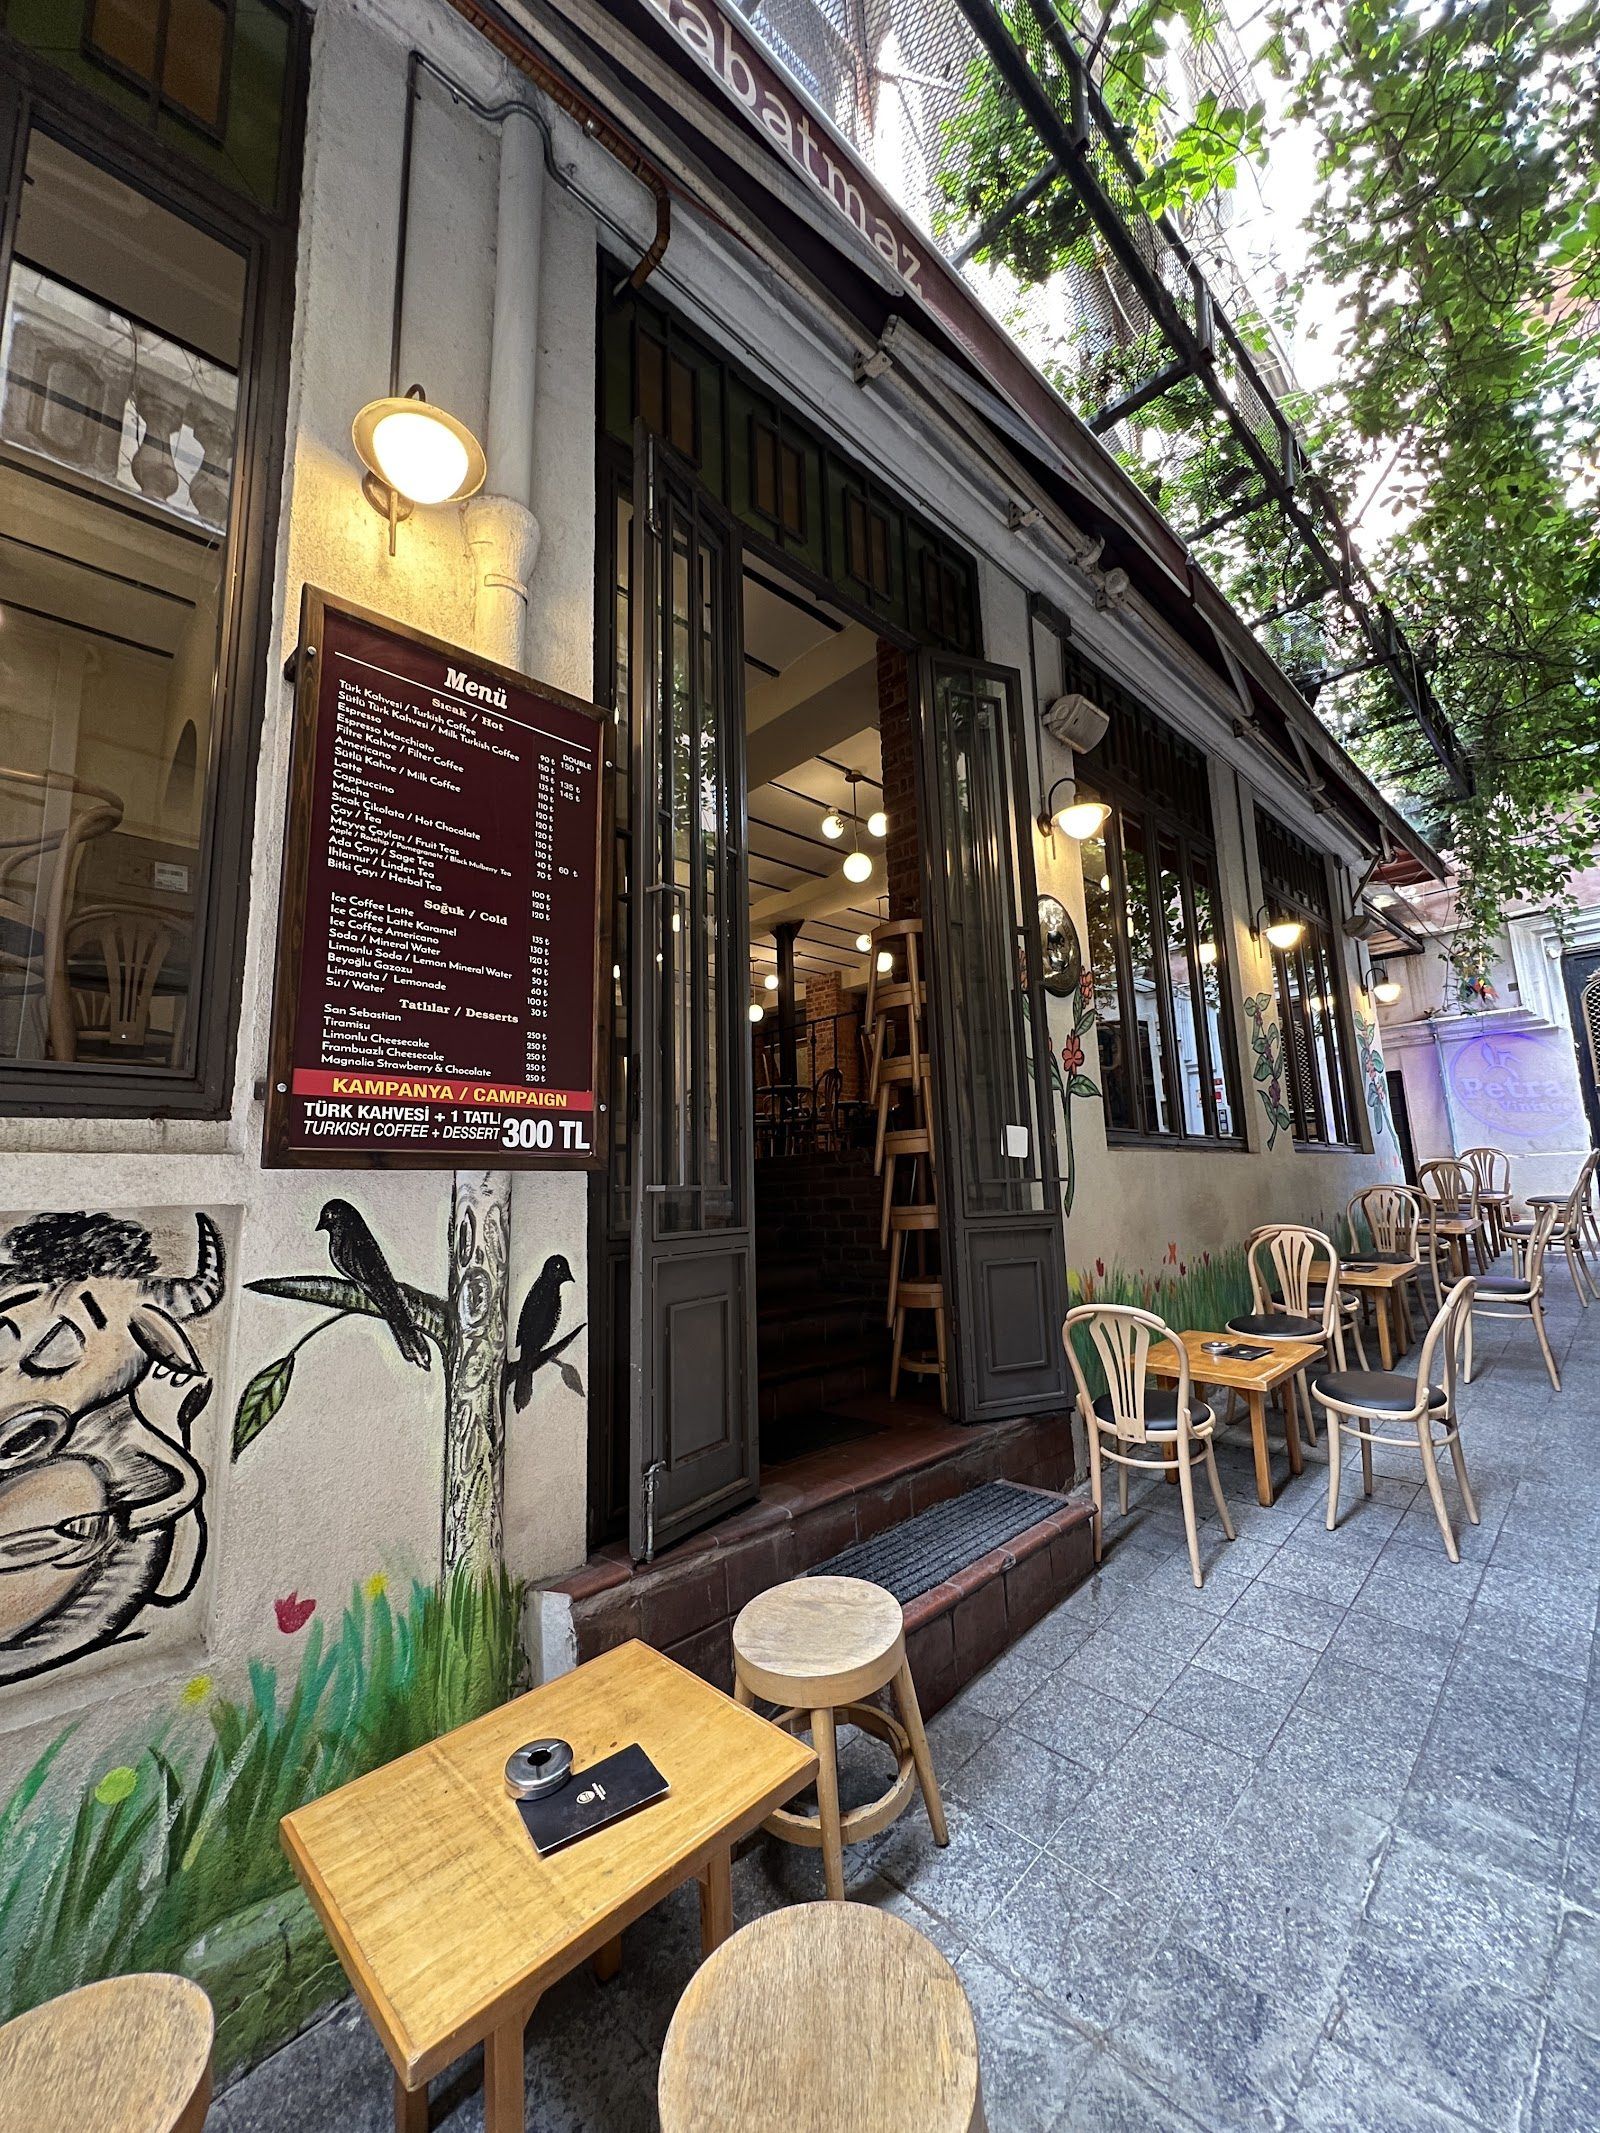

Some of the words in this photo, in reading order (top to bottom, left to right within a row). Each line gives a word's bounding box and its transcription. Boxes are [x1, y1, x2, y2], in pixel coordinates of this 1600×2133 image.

[648, 0, 923, 299] abatmaz
[444, 667, 508, 710] Menü
[338, 702, 382, 724] Espresso
[339, 679, 362, 695] Türk
[364, 688, 402, 709] Kahvesi
[412, 706, 444, 724] Turkish
[446, 719, 476, 736] Coffee
[432, 698, 467, 718] Sıcak
[471, 713, 478, 722] /
[482, 716, 504, 732] Hot
[337, 713, 381, 734] Espresso
[384, 728, 435, 752] Macchiato
[368, 700, 389, 716] Türk
[392, 709, 428, 729] Kahvesi
[438, 726, 458, 740] Milk
[460, 733, 490, 751] Turkish
[492, 746, 520, 762] Coffee
[335, 736, 391, 760] Americano
[336, 724, 363, 740] Filtre
[365, 733, 397, 751] Kahve
[408, 747, 432, 762] Filter
[433, 756, 464, 773] Coffee
[334, 757, 363, 773] Latte
[538, 763, 550, 773] 150
[540, 755, 550, 764] 90
[561, 762, 574, 772] 150
[563, 754, 592, 770] DOUBLE
[333, 769, 394, 794] Cappuccino
[365, 756, 397, 773] Kahve
[407, 769, 428, 783] Milk
[430, 777, 461, 793] Coffee
[540, 774, 549, 782] 115
[333, 780, 370, 798] Mocha
[539, 783, 549, 792] 135
[560, 781, 574, 791] 135
[538, 792, 548, 802] 110
[560, 790, 574, 800] 145
[331, 804, 353, 818] Çay
[364, 812, 382, 824] Tea
[538, 802, 548, 811] 110
[332, 792, 360, 807] Sıcak
[363, 801, 405, 819] Çikolata
[415, 815, 433, 827] Hot
[435, 821, 481, 840] Chocolate
[536, 811, 548, 821] 120
[536, 821, 548, 830] 120
[330, 815, 366, 832] Meyve
[415, 837, 437, 850] Fruit
[439, 843, 459, 856] Teas
[535, 831, 547, 840] 120
[329, 825, 352, 836] Apple
[360, 832, 390, 846] Rosehip
[450, 856, 468, 866] Black
[469, 861, 498, 874] Mulberry
[500, 868, 512, 877] Tea
[329, 835, 352, 848] Ada
[354, 841, 378, 855] Çayı
[389, 850, 415, 864] Sage
[417, 856, 434, 868] Tea
[536, 840, 547, 850] 130
[535, 850, 547, 860] 130
[328, 858, 351, 871] Bitki
[354, 865, 378, 878] Çayı
[389, 872, 423, 888] Herbal
[425, 880, 442, 892] Tea
[381, 859, 416, 875] Linden
[418, 867, 435, 879] Tea
[537, 871, 546, 879] 70
[559, 867, 569, 875] 60
[532, 890, 545, 900] 100
[332, 892, 347, 903] Ice
[349, 896, 385, 911] Coffee
[387, 904, 414, 917] Latte
[424, 900, 465, 916] Soğuk
[469, 910, 476, 919] /
[480, 912, 508, 926] Cold
[532, 901, 545, 910] 120
[331, 904, 346, 915] Ice
[349, 908, 384, 923] Coffee
[387, 915, 414, 928] Latte
[416, 921, 457, 936] Karamel
[532, 911, 544, 920] 120
[330, 916, 346, 927] Ice
[348, 920, 384, 934] Coffee
[385, 927, 439, 944] Americano
[329, 928, 358, 941] Soda
[369, 935, 409, 950] Mineral
[411, 942, 441, 956] Water
[532, 936, 543, 945] 135
[530, 946, 543, 955] 130
[328, 952, 371, 968] Beyoğlu
[374, 960, 413, 974] Gazozu
[329, 940, 373, 956] Limonlu
[375, 948, 402, 961] Soda
[413, 954, 447, 968] Lemon
[449, 961, 484, 975] Mineral
[486, 967, 512, 979] Water
[529, 956, 542, 965] 120
[326, 977, 341, 987] Su
[352, 980, 385, 993] Water
[327, 964, 380, 981] Limonata
[394, 974, 447, 991] Lemonade
[532, 977, 542, 986] 50
[531, 988, 542, 996] 60
[527, 997, 542, 1006] 100
[324, 1004, 346, 1015] San
[349, 1007, 402, 1021] Sebastian
[399, 999, 450, 1014] Tatlılar
[454, 1006, 462, 1017] /
[466, 1008, 518, 1023] Desserts
[531, 1008, 541, 1017] 30
[324, 1016, 370, 1030] Tiramisu
[323, 1028, 368, 1042] Limonlu
[370, 1034, 430, 1048] Cheesecake
[527, 1032, 541, 1040] 250
[322, 1041, 384, 1056] Frambuazlı
[386, 1048, 444, 1061] Cheesecake
[527, 1042, 541, 1050] 250
[321, 1054, 374, 1067] Magnolia
[377, 1059, 433, 1074] Strawberry
[435, 1063, 443, 1073] &
[445, 1065, 491, 1077] Chocolate
[526, 1053, 540, 1061] 250
[526, 1063, 540, 1072] 250
[525, 1074, 540, 1082] 250
[333, 1078, 454, 1100] KAMPANYA
[459, 1087, 468, 1100] /
[474, 1088, 567, 1107] CAMPAIGN
[1460, 1077, 1564, 1099] Petra
[304, 1100, 353, 1118] TÜRK
[358, 1105, 429, 1122] KAHVESİ
[434, 1113, 446, 1122] +
[451, 1110, 458, 1123] 1
[463, 1111, 501, 1125] TATLI
[304, 1120, 371, 1136] TURKISH
[374, 1123, 430, 1138] COFFEE
[432, 1129, 440, 1138] +
[443, 1126, 501, 1140] DESSERT
[502, 1118, 553, 1149] 300
[559, 1120, 590, 1150] TL
